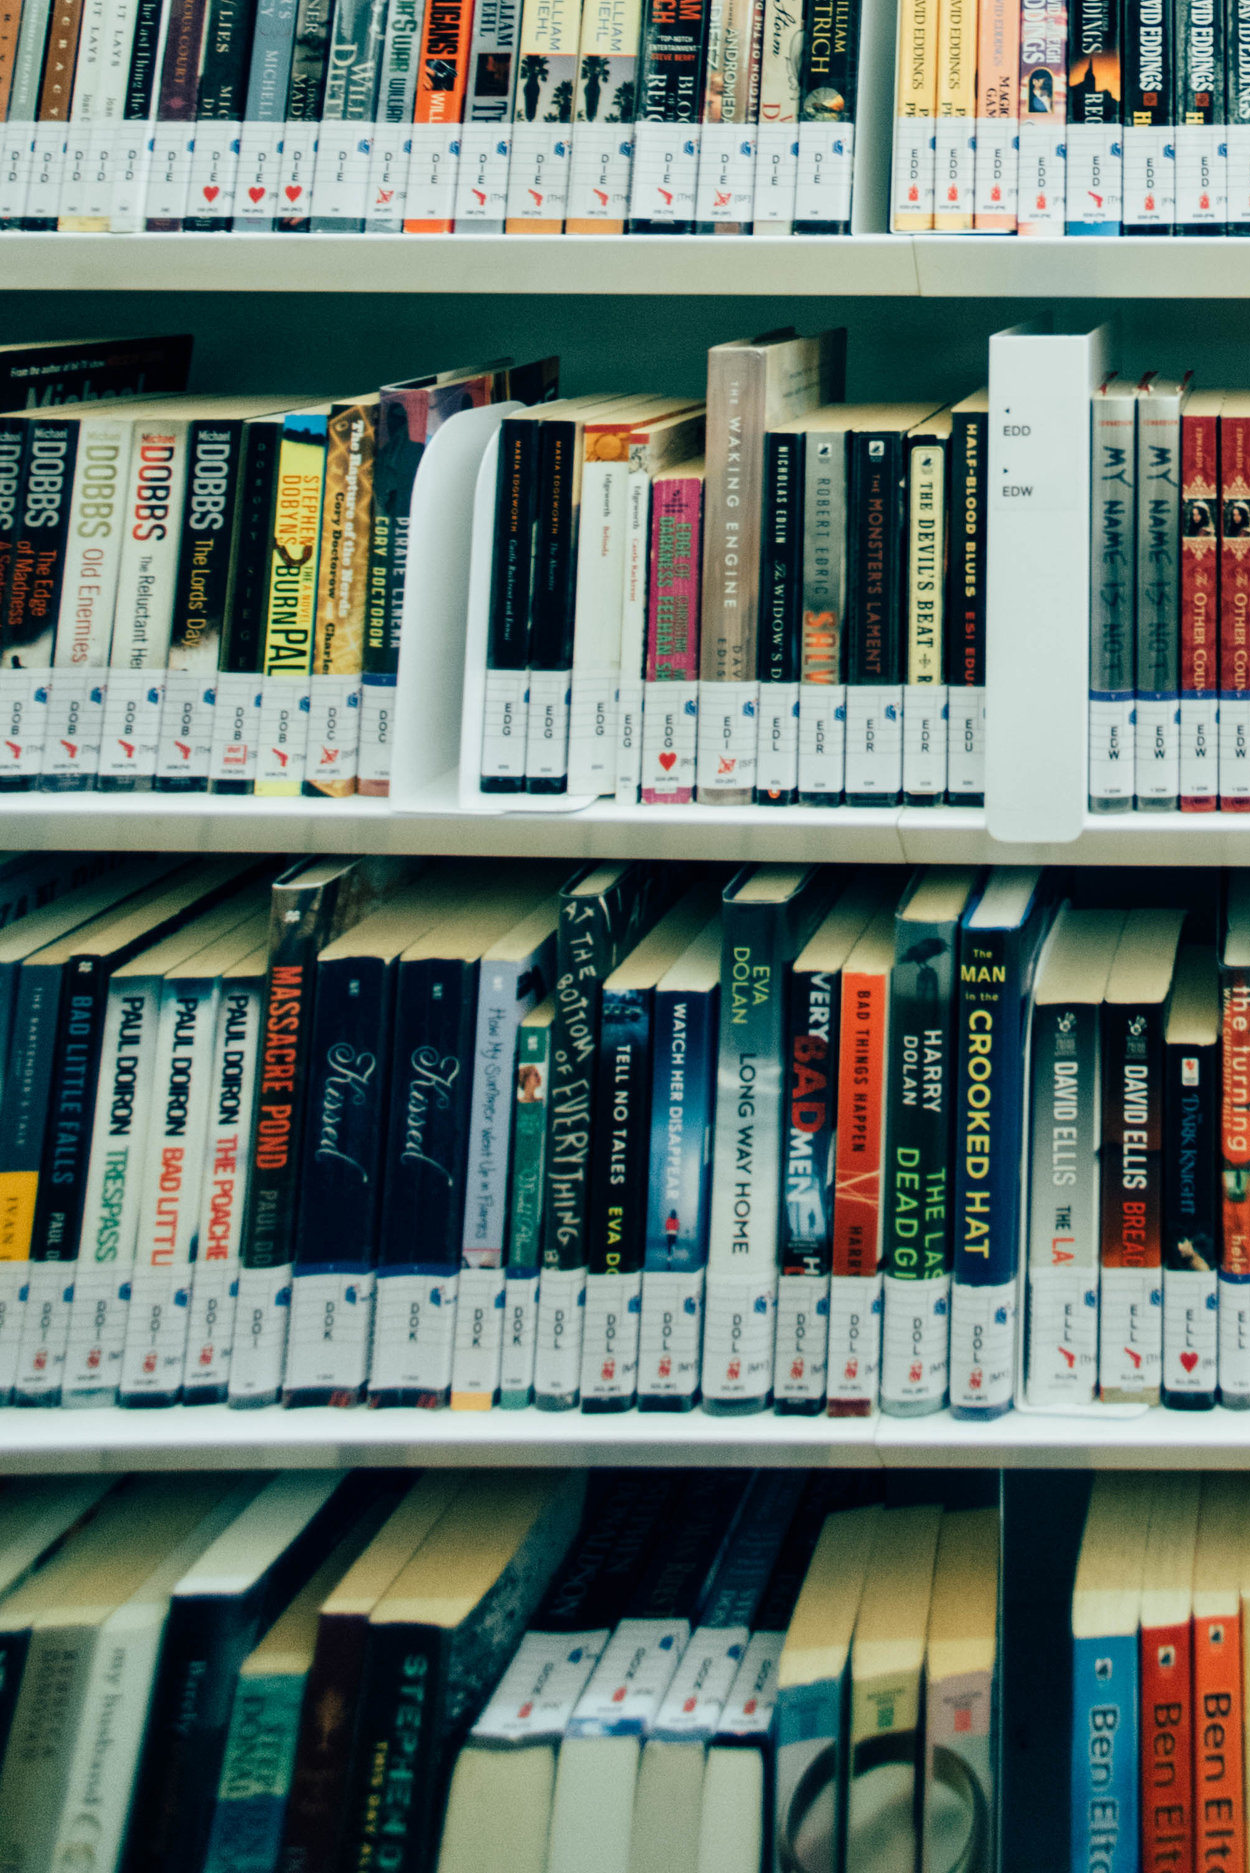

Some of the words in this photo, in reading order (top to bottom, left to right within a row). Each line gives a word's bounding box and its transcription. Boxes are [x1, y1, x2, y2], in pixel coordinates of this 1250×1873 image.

[1139, 26, 1161, 91] EDDINGS
[729, 380, 740, 404] THE
[1003, 426, 1030, 436] EDD
[24, 440, 66, 527] DOBBS
[727, 416, 741, 508] WAKING
[966, 424, 977, 536] HALF-BLOOD
[1003, 486, 1033, 497] EDW
[132, 446, 175, 542] DOBBS
[281, 474, 302, 549] DOBYNS
[302, 476, 318, 546] STEPHEN
[816, 478, 830, 537] ROBERT
[920, 482, 934, 513] THE
[724, 523, 738, 609] ENGINE
[814, 543, 829, 596] EDRIC
[917, 520, 935, 594] DEVIL'S
[964, 544, 976, 597] BLUES
[274, 566, 301, 624] BURN
[916, 600, 934, 649] BEAT
[268, 628, 308, 676] PAL
[732, 947, 750, 1025] DOLAN
[752, 966, 770, 1006] EVA
[962, 965, 1005, 983] MAN
[115, 996, 144, 1053] PAUL
[262, 965, 303, 1092] MASSACRE
[671, 1004, 687, 1064] WATCH
[615, 1044, 631, 1085] TELL
[669, 1067, 685, 1104] HER
[738, 1053, 756, 1115] LONG
[966, 1010, 993, 1179] CROOKED
[1052, 1062, 1078, 1120] DAVID
[107, 1057, 138, 1136] DOIRON
[315, 1042, 376, 1183] Kissed
[613, 1092, 629, 1121] NO
[256, 1103, 292, 1170] POND
[609, 1127, 627, 1185] TALES
[665, 1108, 685, 1200] DISAPPEAR
[735, 1122, 755, 1178] WAY
[1052, 1128, 1077, 1186] ELLIS
[95, 1146, 129, 1264] TRESPASS
[732, 1184, 752, 1255] HOME
[963, 1192, 990, 1258] HAT
